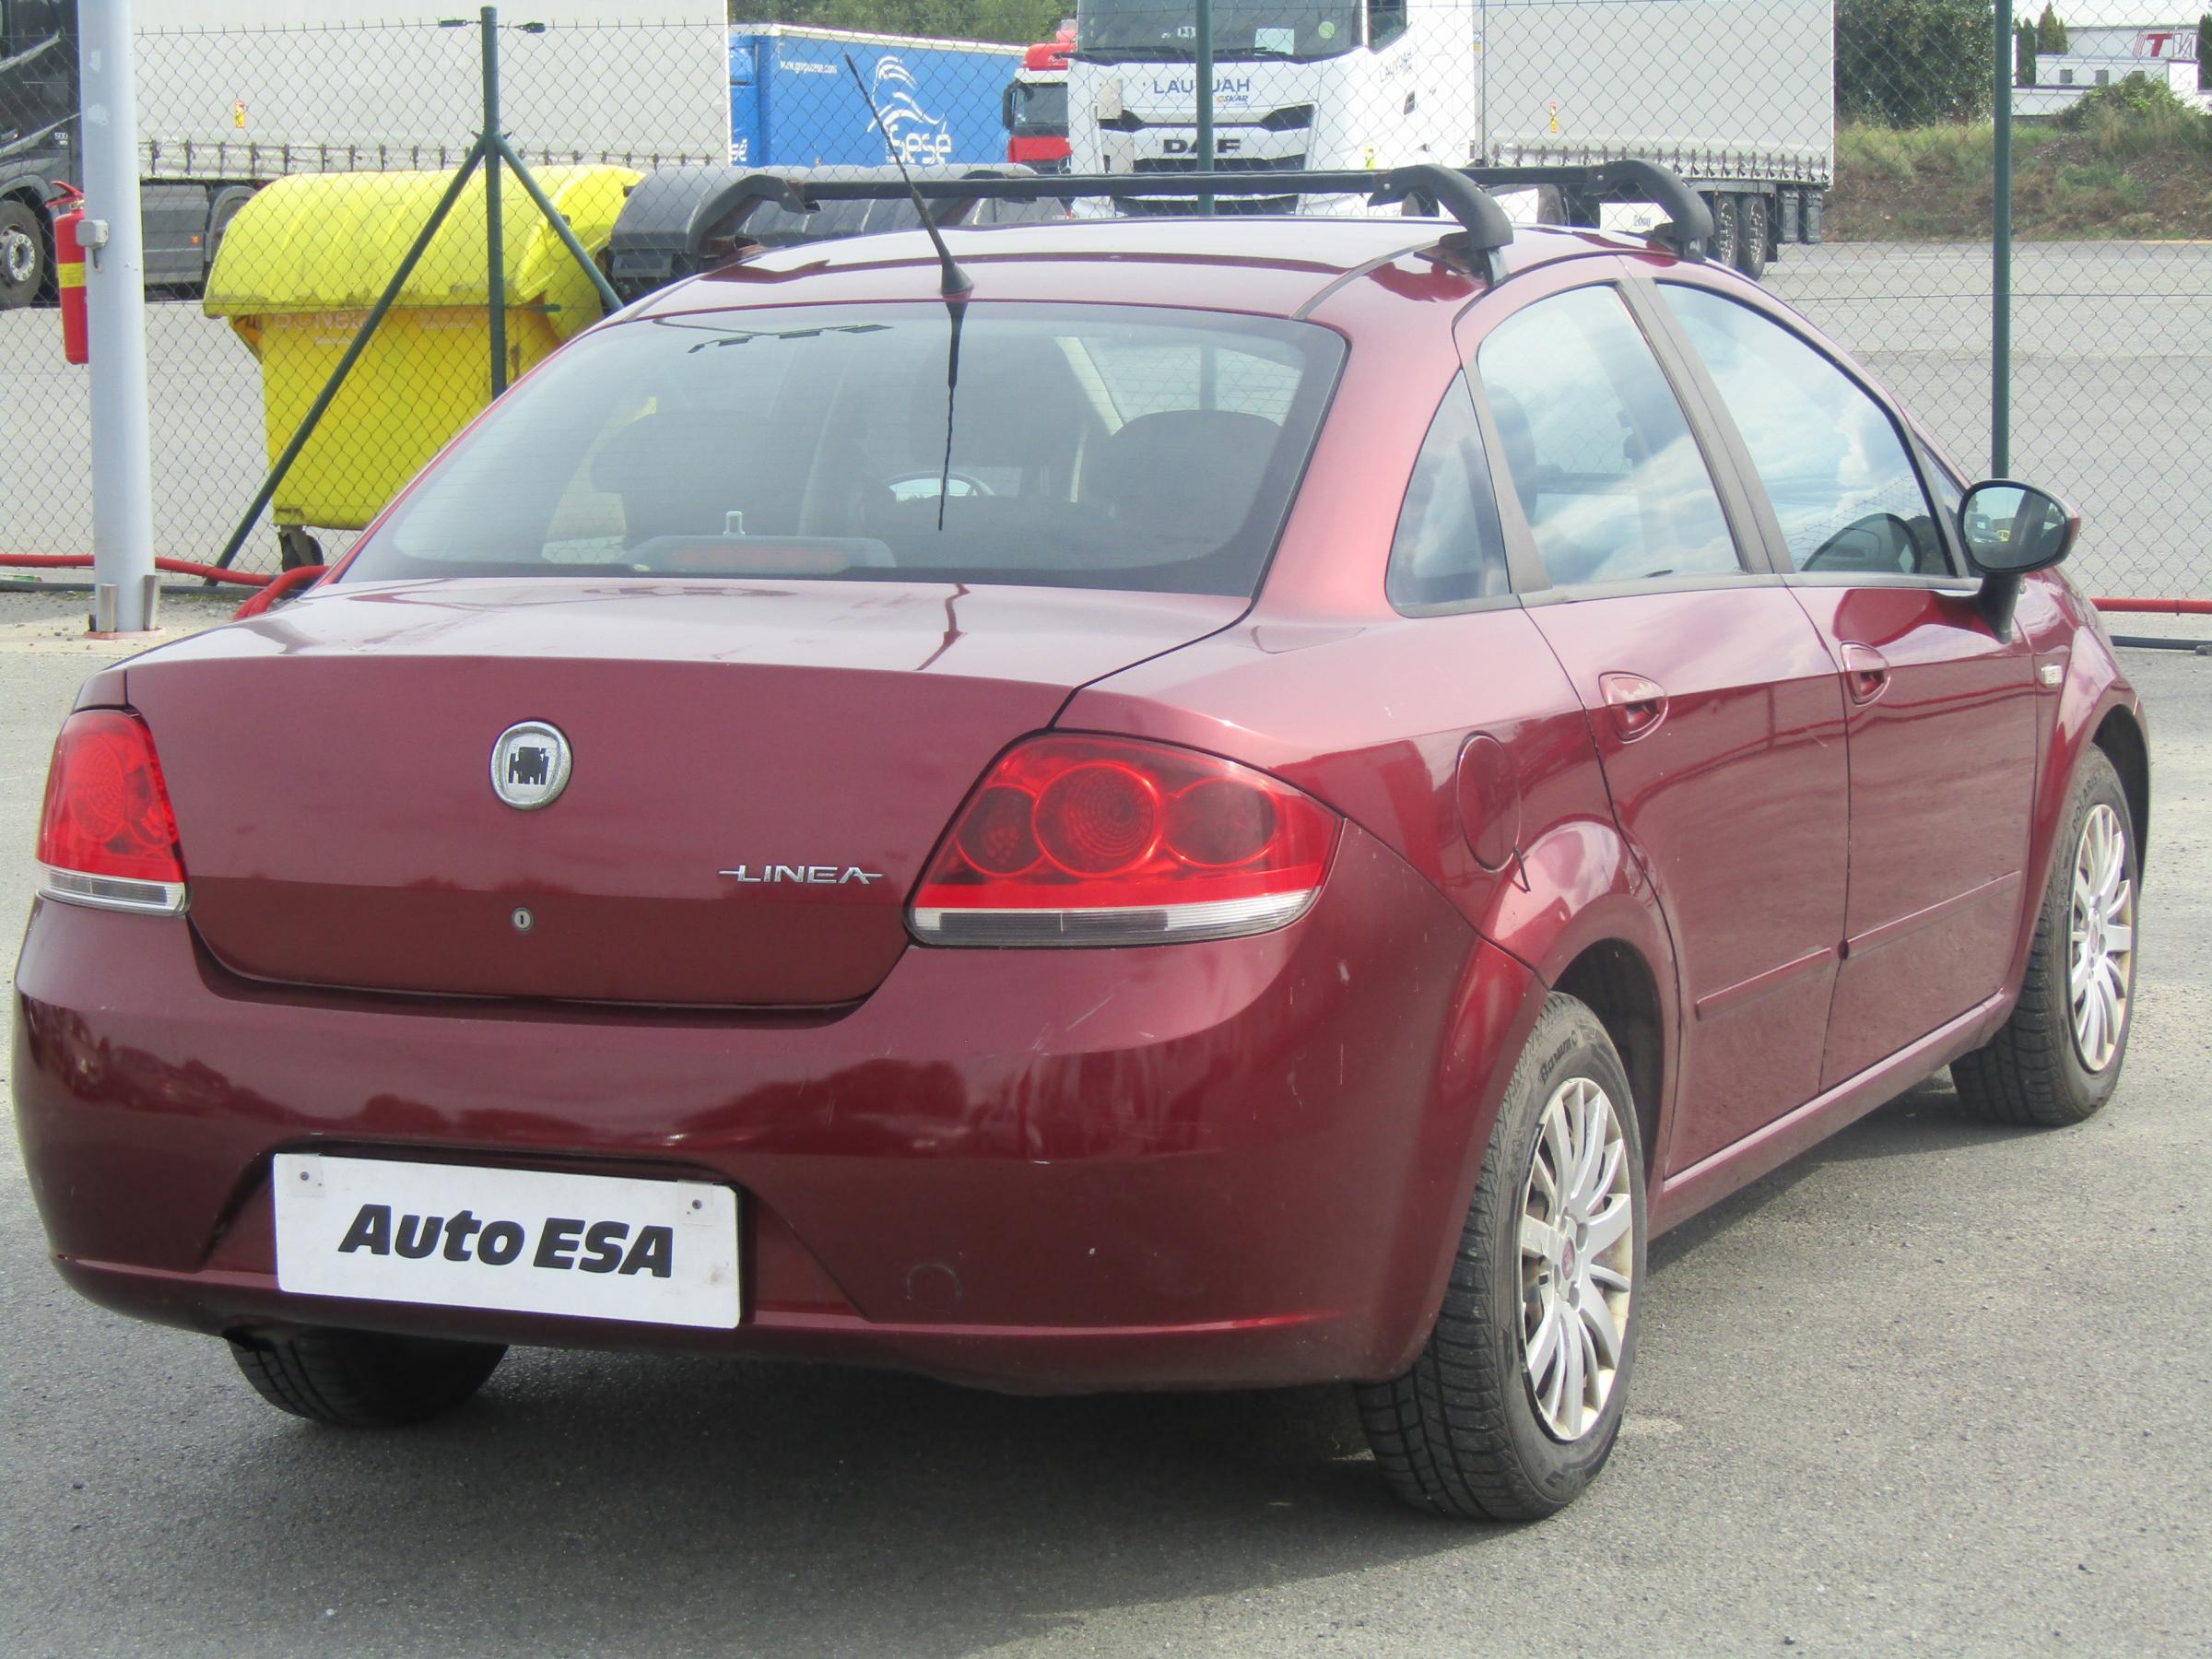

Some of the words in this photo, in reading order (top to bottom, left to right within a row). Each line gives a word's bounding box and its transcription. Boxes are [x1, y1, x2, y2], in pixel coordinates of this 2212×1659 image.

[719, 864, 884, 885] LINEA
[337, 1204, 525, 1267] Auto
[533, 1217, 674, 1278] ESA
